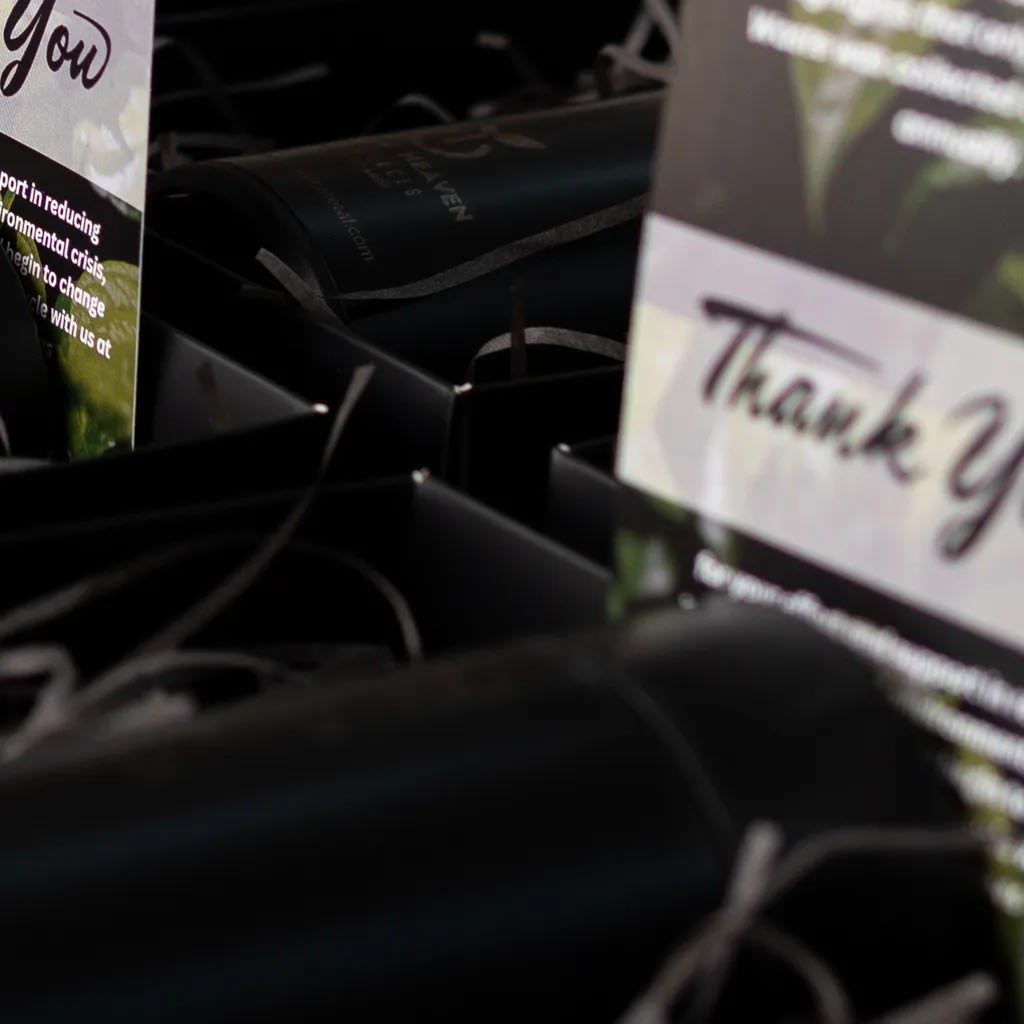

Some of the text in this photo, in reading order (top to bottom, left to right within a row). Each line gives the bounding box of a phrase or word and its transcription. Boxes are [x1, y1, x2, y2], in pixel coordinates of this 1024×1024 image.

[29, 181, 42, 208] in
[44, 194, 101, 246] reducing
[43, 264, 57, 289] to
[59, 274, 106, 319] change
[70, 248, 106, 287] crisis,
[50, 306, 78, 339] with
[79, 325, 95, 350] us
[96, 336, 113, 360] at
[698, 295, 926, 488] Thank
